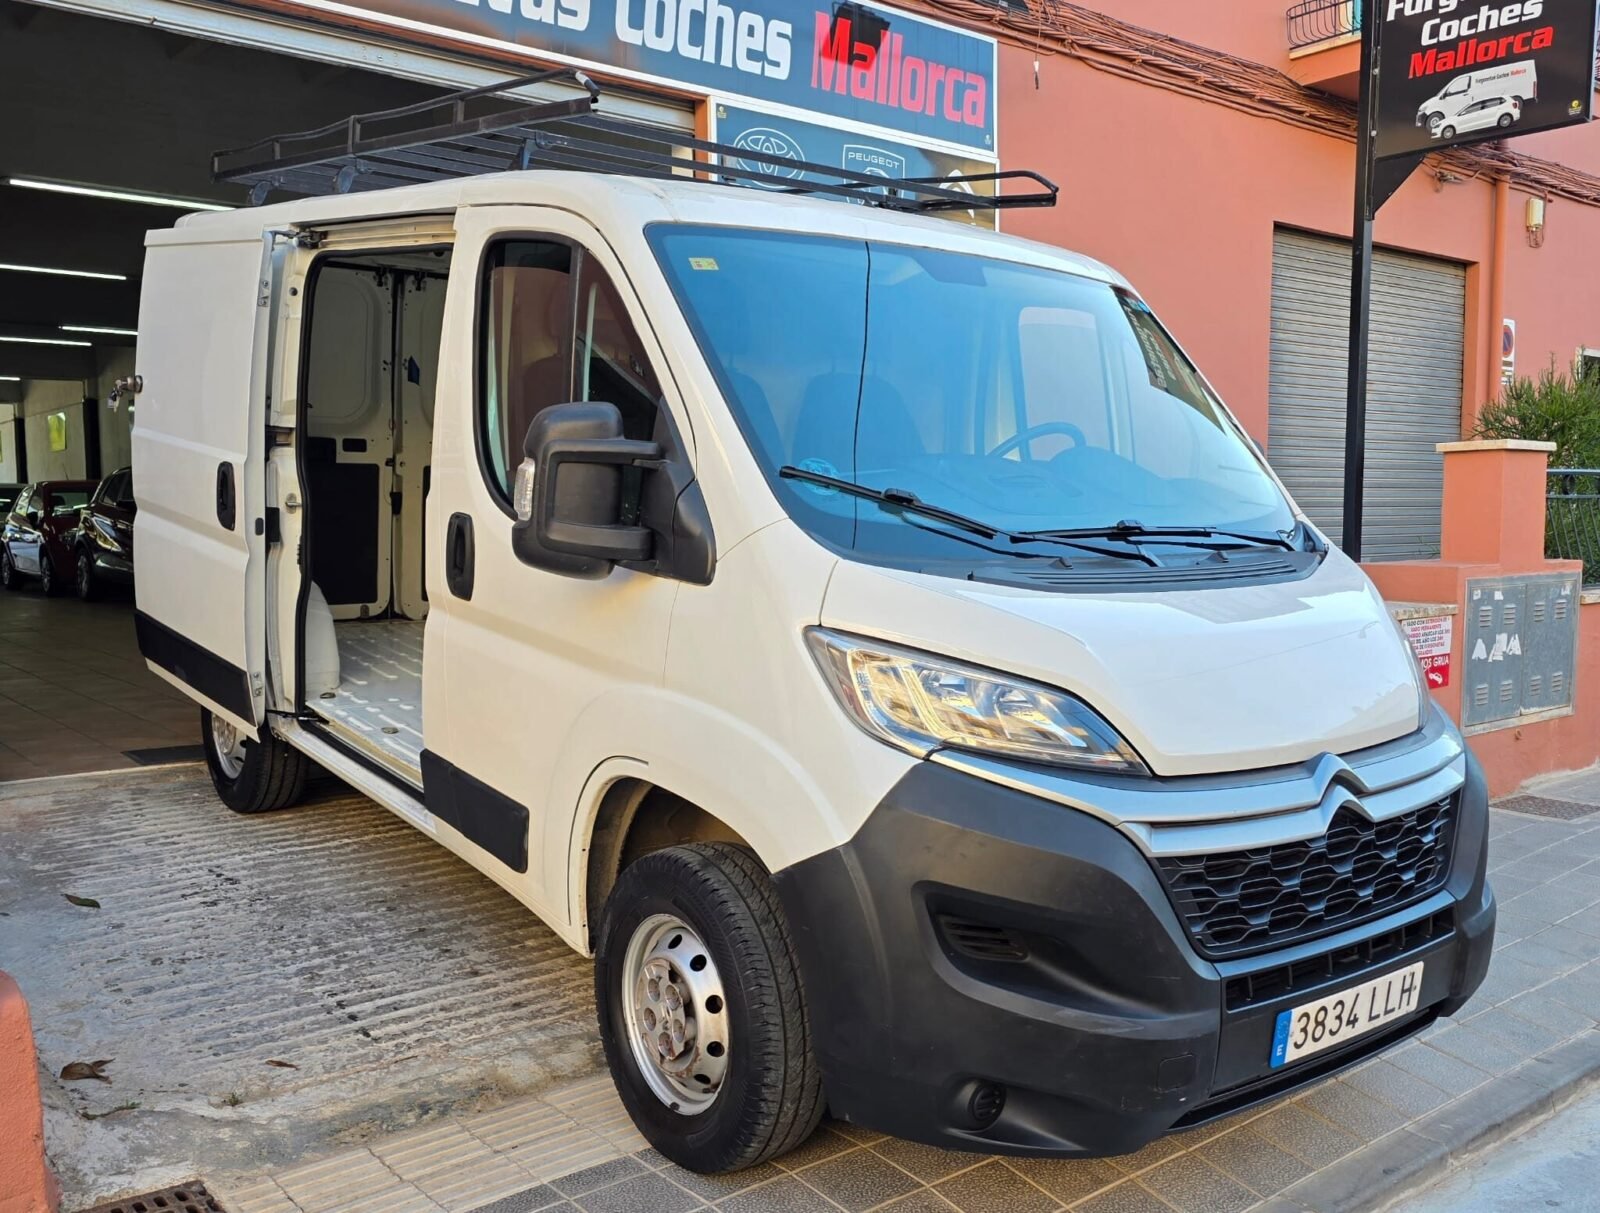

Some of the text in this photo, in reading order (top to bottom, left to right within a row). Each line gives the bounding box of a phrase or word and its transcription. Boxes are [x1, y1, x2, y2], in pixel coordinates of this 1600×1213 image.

[1421, 0, 1544, 46] Coches
[614, 0, 793, 81] Coches
[811, 9, 987, 128] Mallorca
[1408, 26, 1553, 79] Mallorca
[848, 152, 900, 169] PEUGEOT
[1433, 656, 1449, 667] GRUA
[1293, 971, 1416, 1050] 3834 LLH
[1276, 1044, 1284, 1056] E
